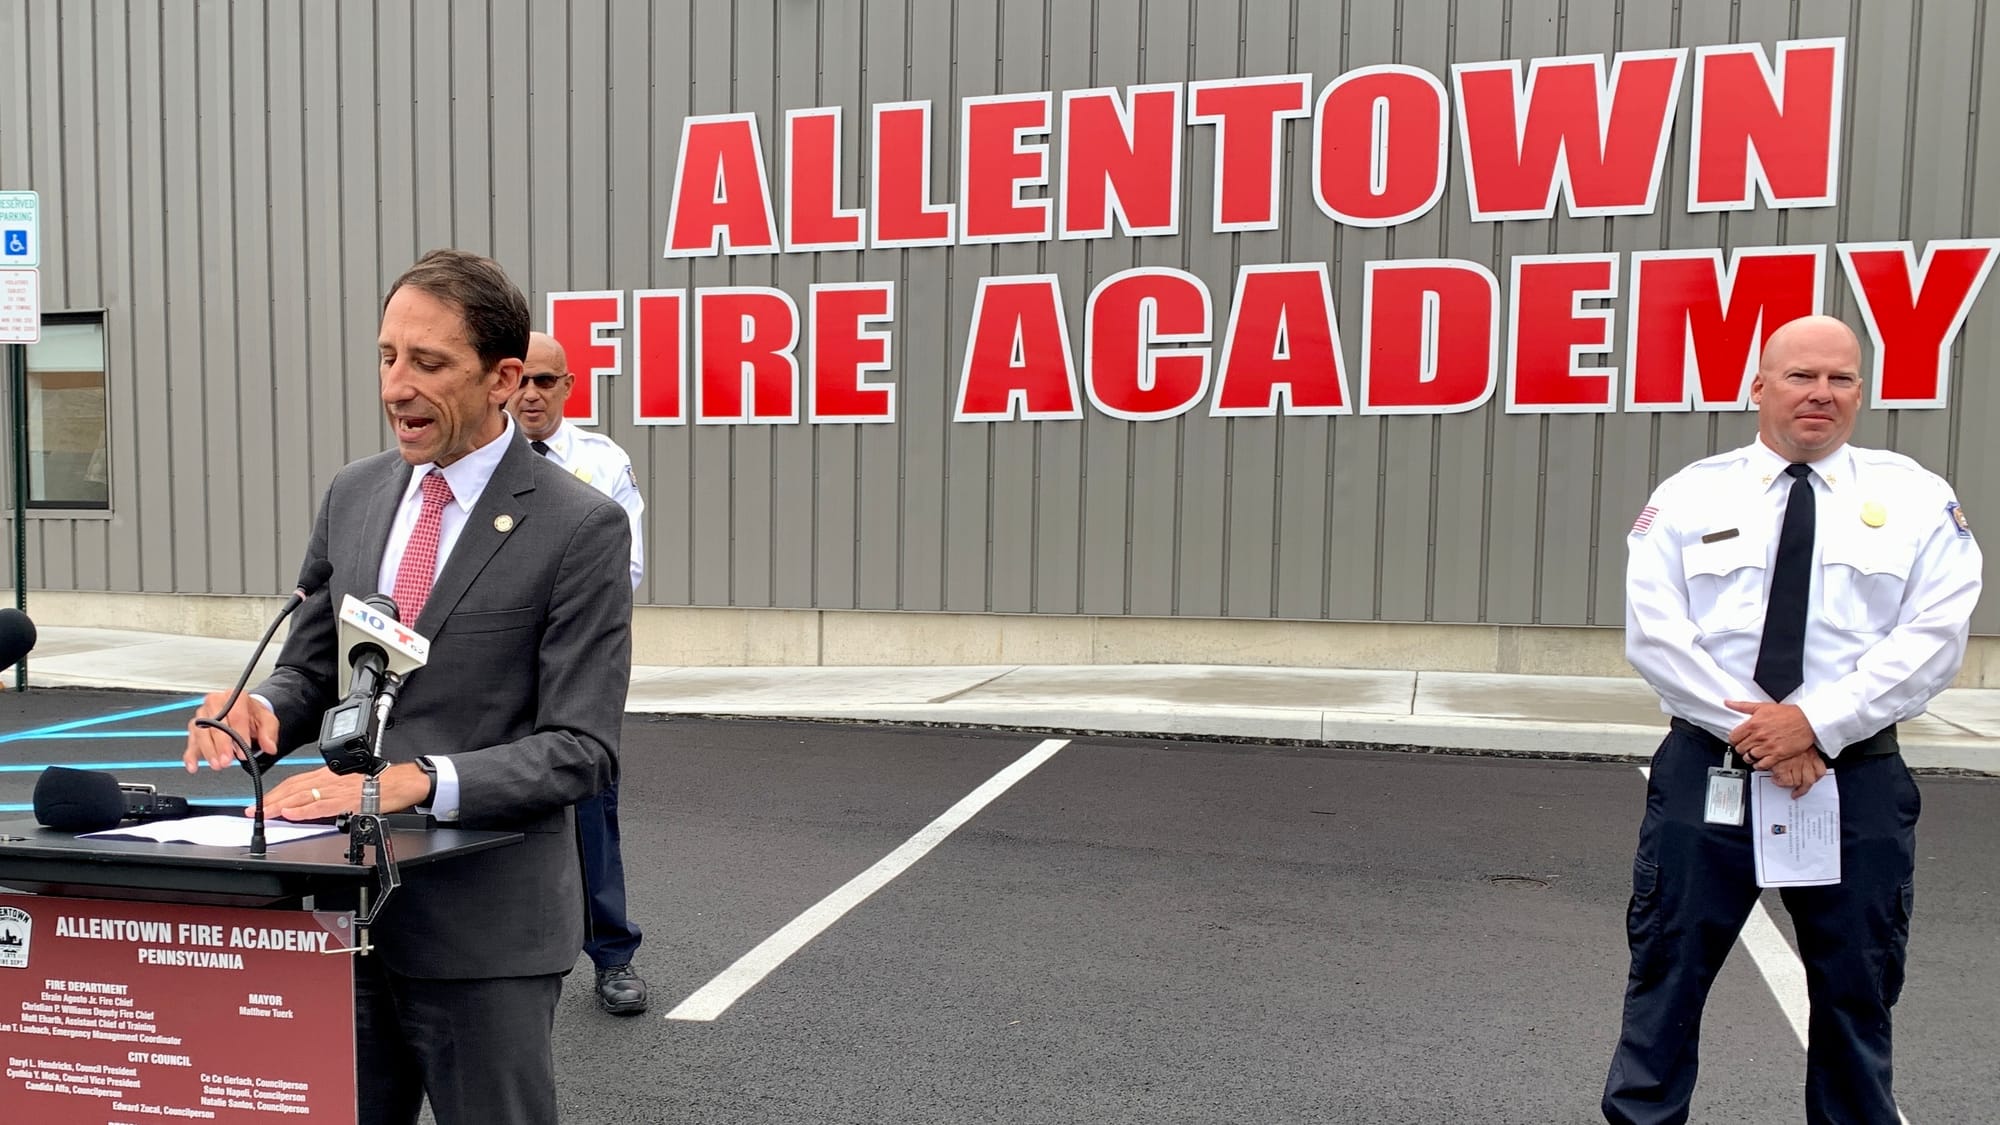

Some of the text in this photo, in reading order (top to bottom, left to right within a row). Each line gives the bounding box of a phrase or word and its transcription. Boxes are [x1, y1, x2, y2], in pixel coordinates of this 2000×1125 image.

[664, 37, 1846, 259] ALLENTOWN
[546, 239, 2000, 427] FIRE ACADEMY
[0, 908, 30, 923] ENTOWN
[56, 917, 329, 953] ALLENTOWN FIRE ACADEMY
[138, 949, 244, 970] PENNSYLVANIA
[45, 980, 128, 995] FIRE DEPARTMENT
[99, 997, 114, 1006] Fire
[115, 998, 133, 1007] Chief
[248, 993, 283, 1006] MAYOR
[22, 1002, 154, 1020] Christian P. Williams Deputy Fire Chief
[239, 1006, 271, 1017] Matthew
[65, 1016, 97, 1027] Assistant
[98, 1018, 117, 1029] Chief
[118, 1020, 126, 1029] of
[127, 1021, 156, 1033] Training
[12, 1023, 19, 1032] T.
[53, 1027, 91, 1040] Emergency
[93, 1030, 138, 1042] Management
[140, 1033, 182, 1045] Coordinator
[29, 1059, 36, 1068] L.
[37, 1060, 75, 1071] Hendricks,
[75, 1062, 101, 1073] Council
[102, 1065, 137, 1076] President
[128, 1051, 192, 1067] CITY COUNCIL
[34, 1071, 40, 1080] Y.
[62, 1074, 89, 1084] Council
[89, 1076, 106, 1085] Vice
[106, 1078, 141, 1088] President
[200, 1073, 211, 1083] Ce
[212, 1074, 222, 1084] Ce
[255, 1078, 309, 1091] Councilperson
[72, 1086, 122, 1098] Councilperson
[253, 1090, 306, 1102] Councilperson
[112, 1101, 140, 1113] Edward
[163, 1106, 215, 1119] Councilperson
[256, 1102, 310, 1115] Councilperson
